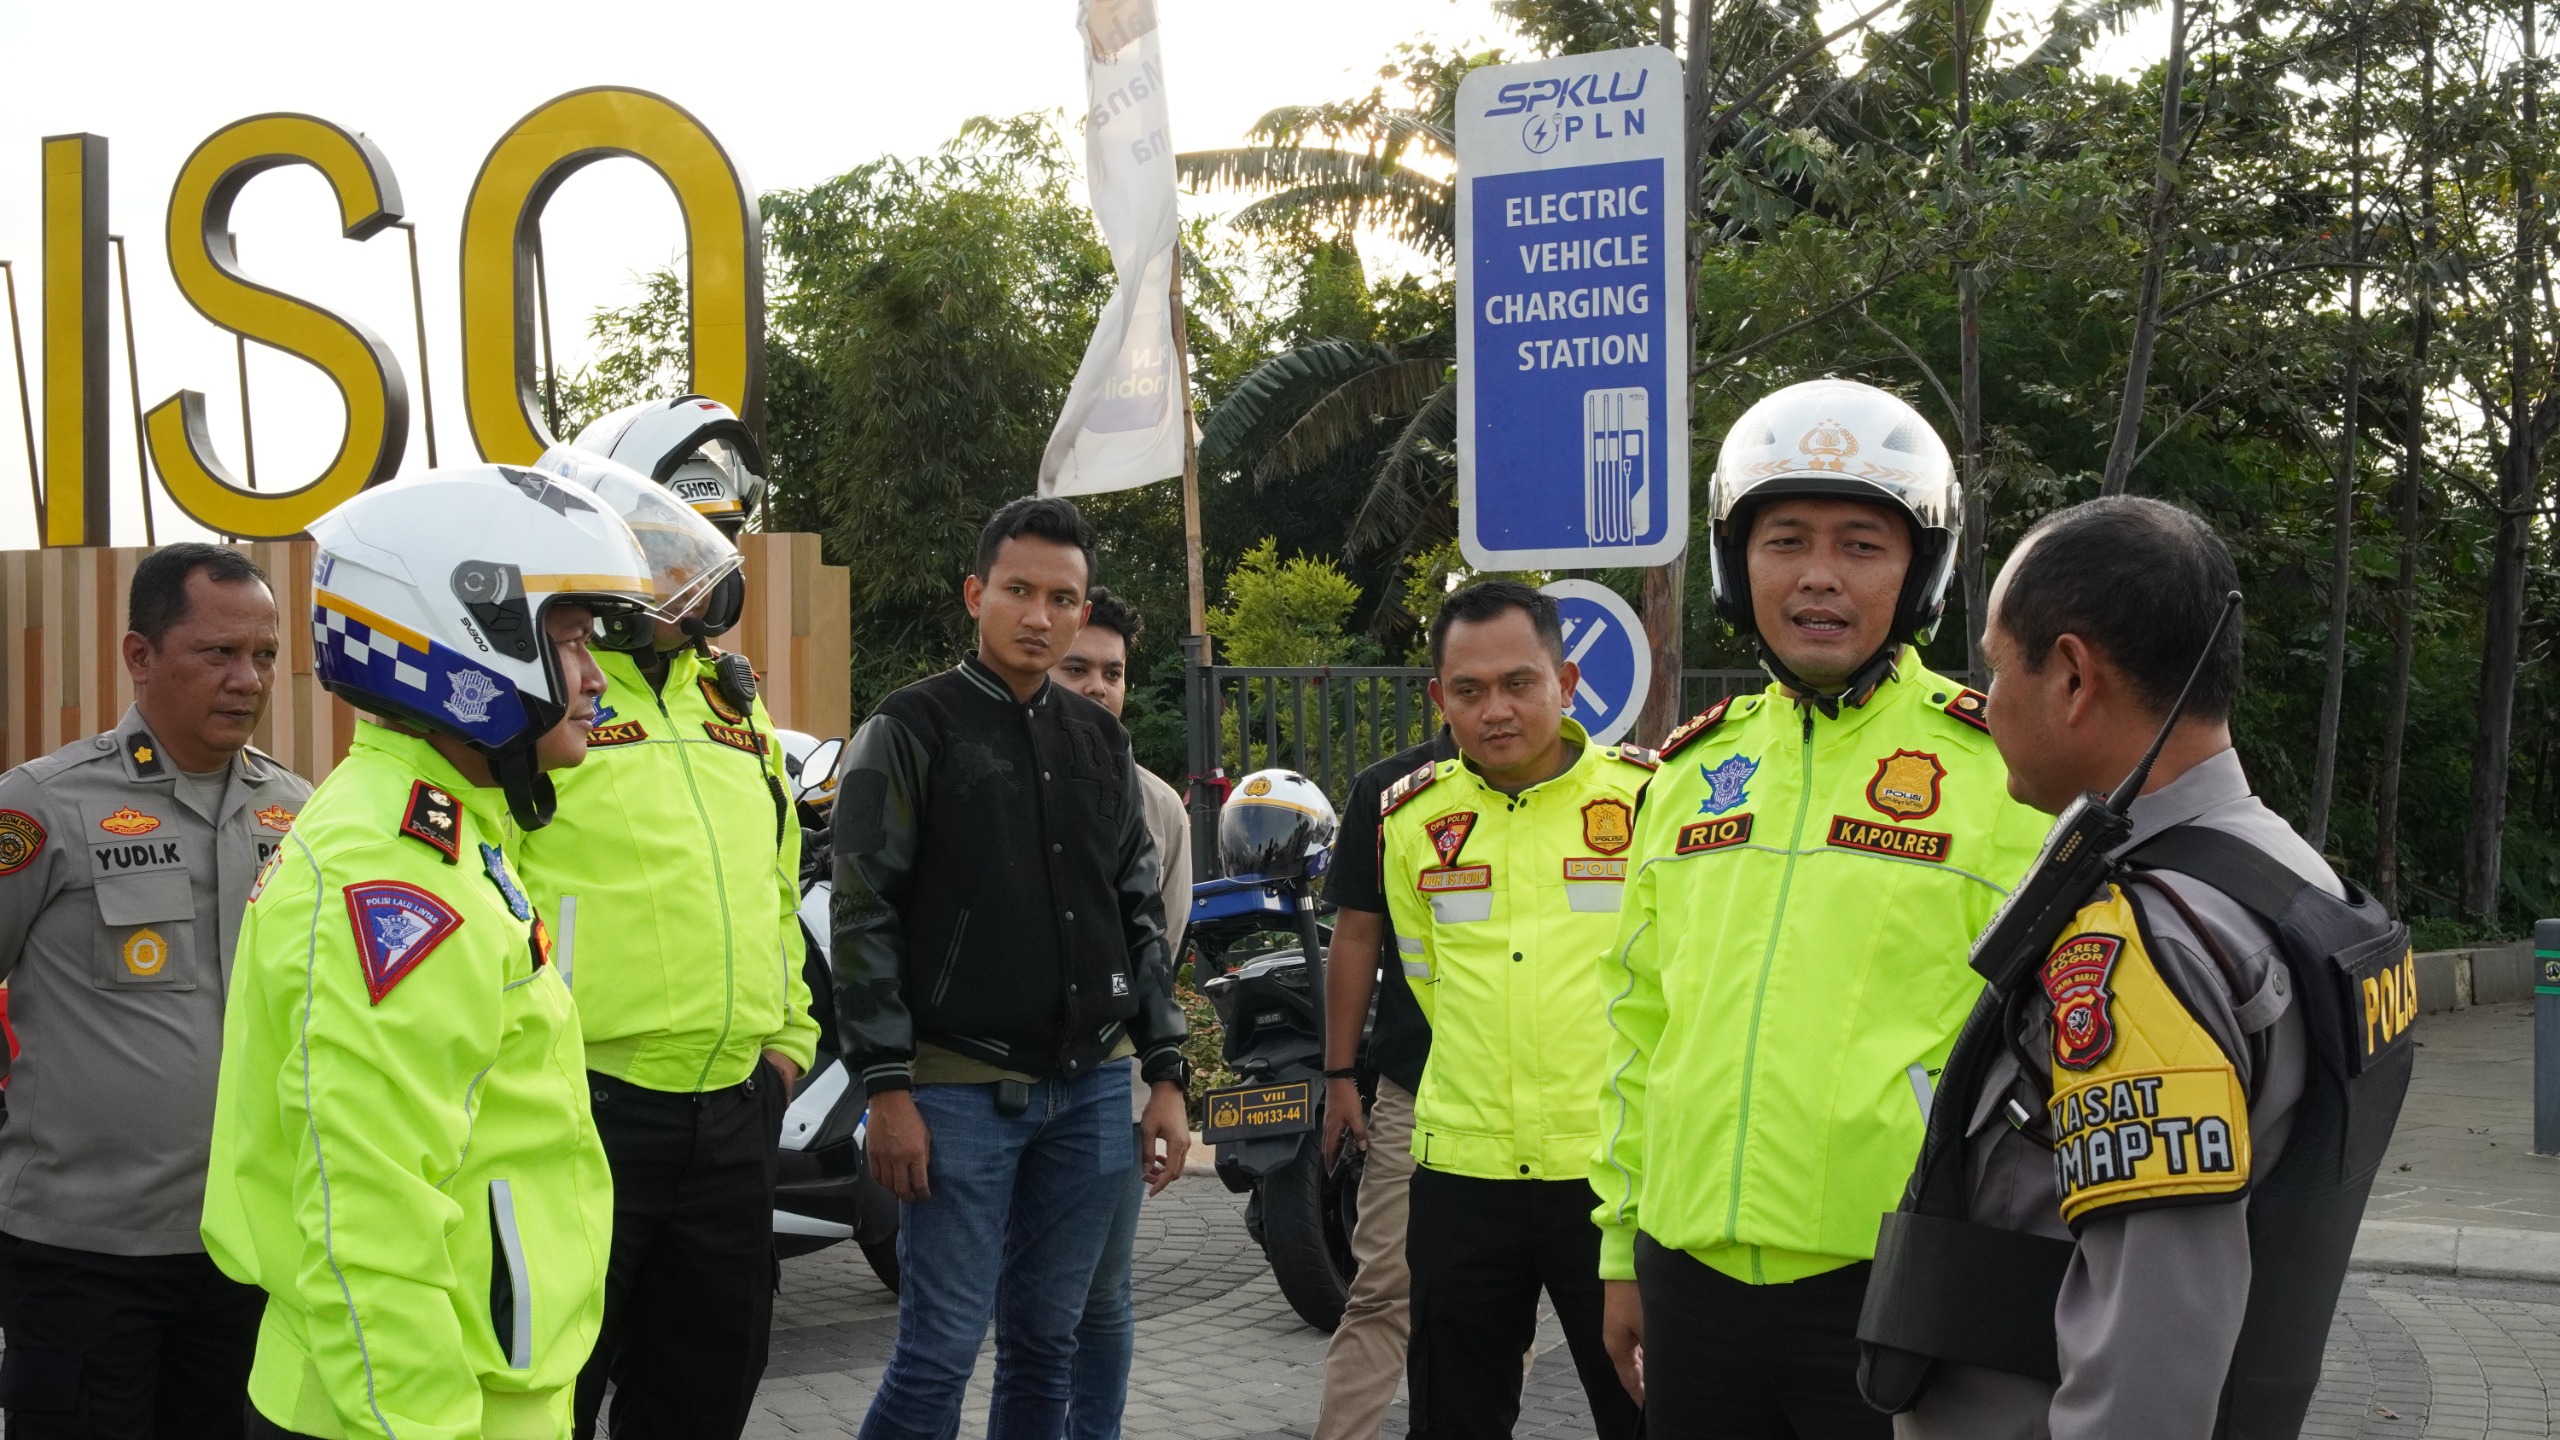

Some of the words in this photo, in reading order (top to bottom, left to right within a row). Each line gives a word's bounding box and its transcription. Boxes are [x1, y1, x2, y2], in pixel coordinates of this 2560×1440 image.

[1484, 68, 1648, 117] SPKLU
[1565, 108, 1645, 142] PLN
[1505, 184, 1649, 228] ELECTRIC
[1519, 234, 1649, 274] VEHICLE
[1485, 283, 1649, 325] CHARGING
[1518, 333, 1649, 371] STATION
[676, 481, 721, 500] SHOEI
[460, 616, 489, 653] SV300
[587, 725, 639, 742] IZKI
[1885, 788, 1922, 802] POLISI
[1430, 820, 1446, 832] OPS
[1447, 814, 1470, 825] POLRI
[1689, 820, 1739, 847] RIO
[1839, 822, 1940, 856] KAPOLRES
[96, 842, 181, 871] YUDI.K
[1571, 862, 1627, 877] POLI
[366, 897, 391, 906] POLISI
[392, 898, 413, 910] LALU
[413, 905, 439, 924] LINTAS
[2049, 953, 2104, 978] BOGOR
[2051, 943, 2101, 969] POLRES
[2054, 977, 2073, 994] JAWA
[2074, 972, 2099, 983] BARAT
[1262, 1091, 1286, 1102] VIII
[1246, 1106, 1301, 1125] 110133-44
[2053, 1076, 2163, 1145] KASAT
[2053, 1116, 2235, 1200] AMAPTA
